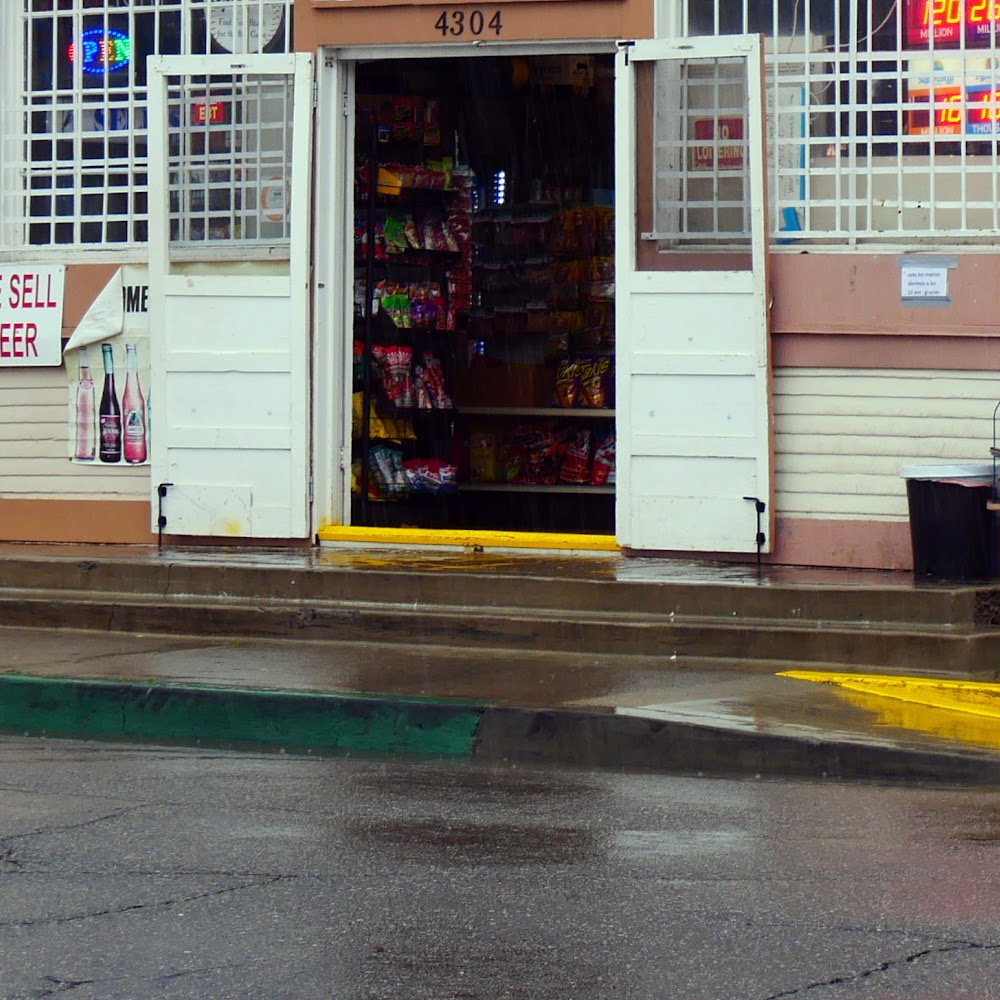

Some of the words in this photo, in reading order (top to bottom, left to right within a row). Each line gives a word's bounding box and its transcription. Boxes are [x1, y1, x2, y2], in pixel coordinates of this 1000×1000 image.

[434, 10, 503, 37] 4304
[9, 273, 57, 309] SELL
[122, 285, 149, 313] ME
[0, 322, 38, 357] EER
